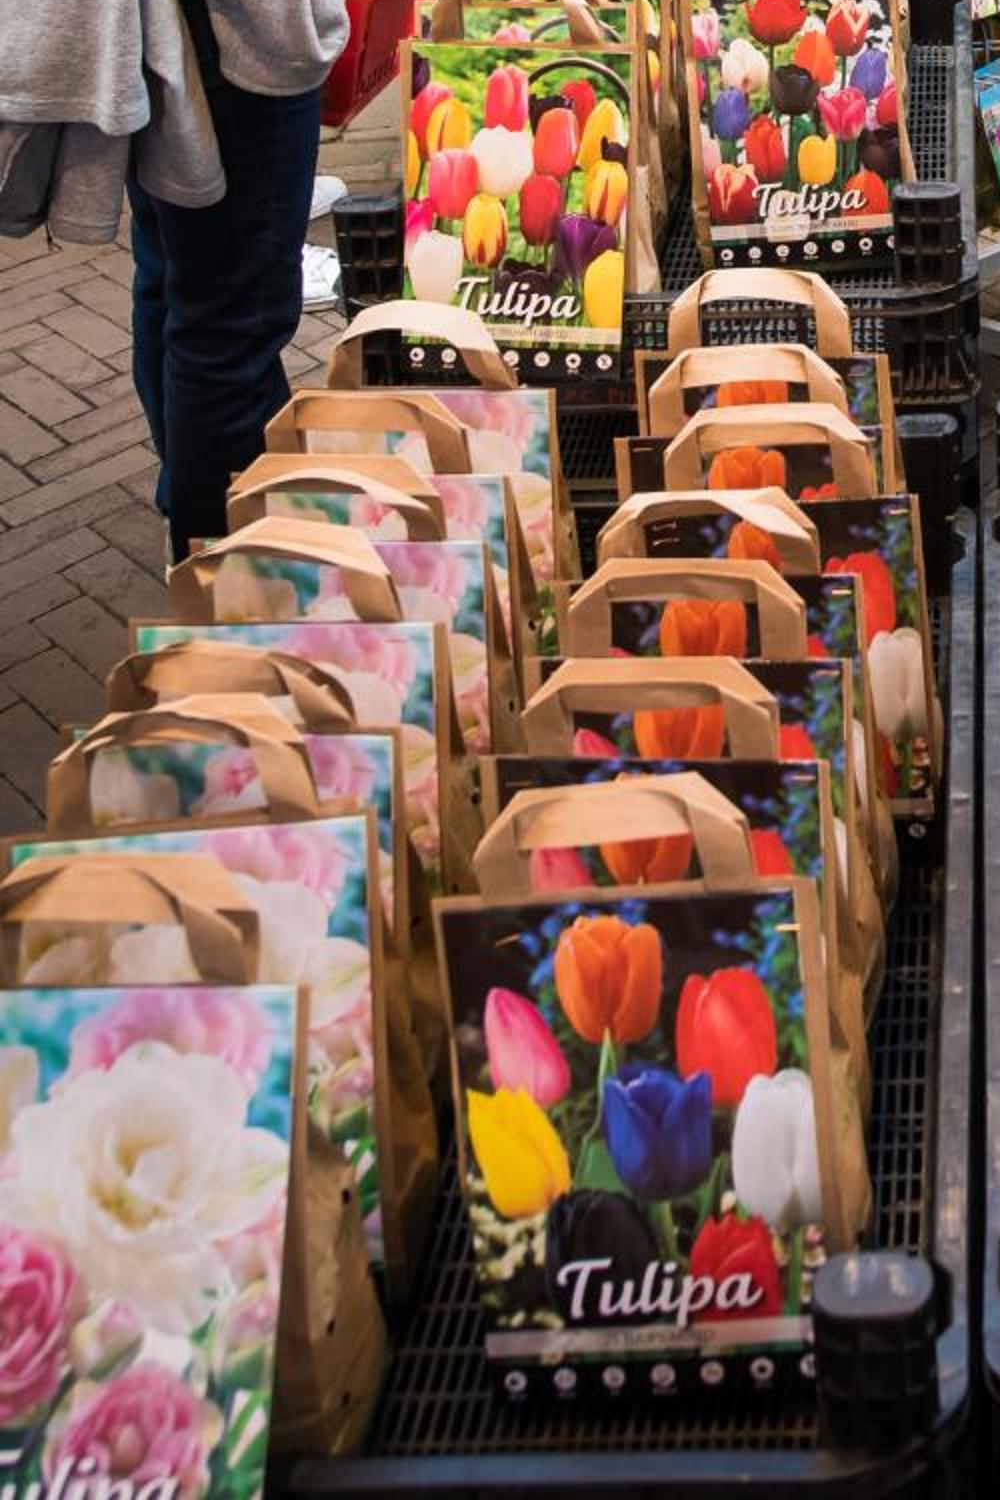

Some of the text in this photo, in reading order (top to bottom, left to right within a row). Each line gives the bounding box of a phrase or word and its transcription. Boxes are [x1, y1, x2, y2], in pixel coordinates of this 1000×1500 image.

[752, 181, 867, 221] Tulipa
[455, 276, 581, 329] Tulipa
[557, 1257, 763, 1328] Tulipa
[0, 1449, 180, 1500] ulia
